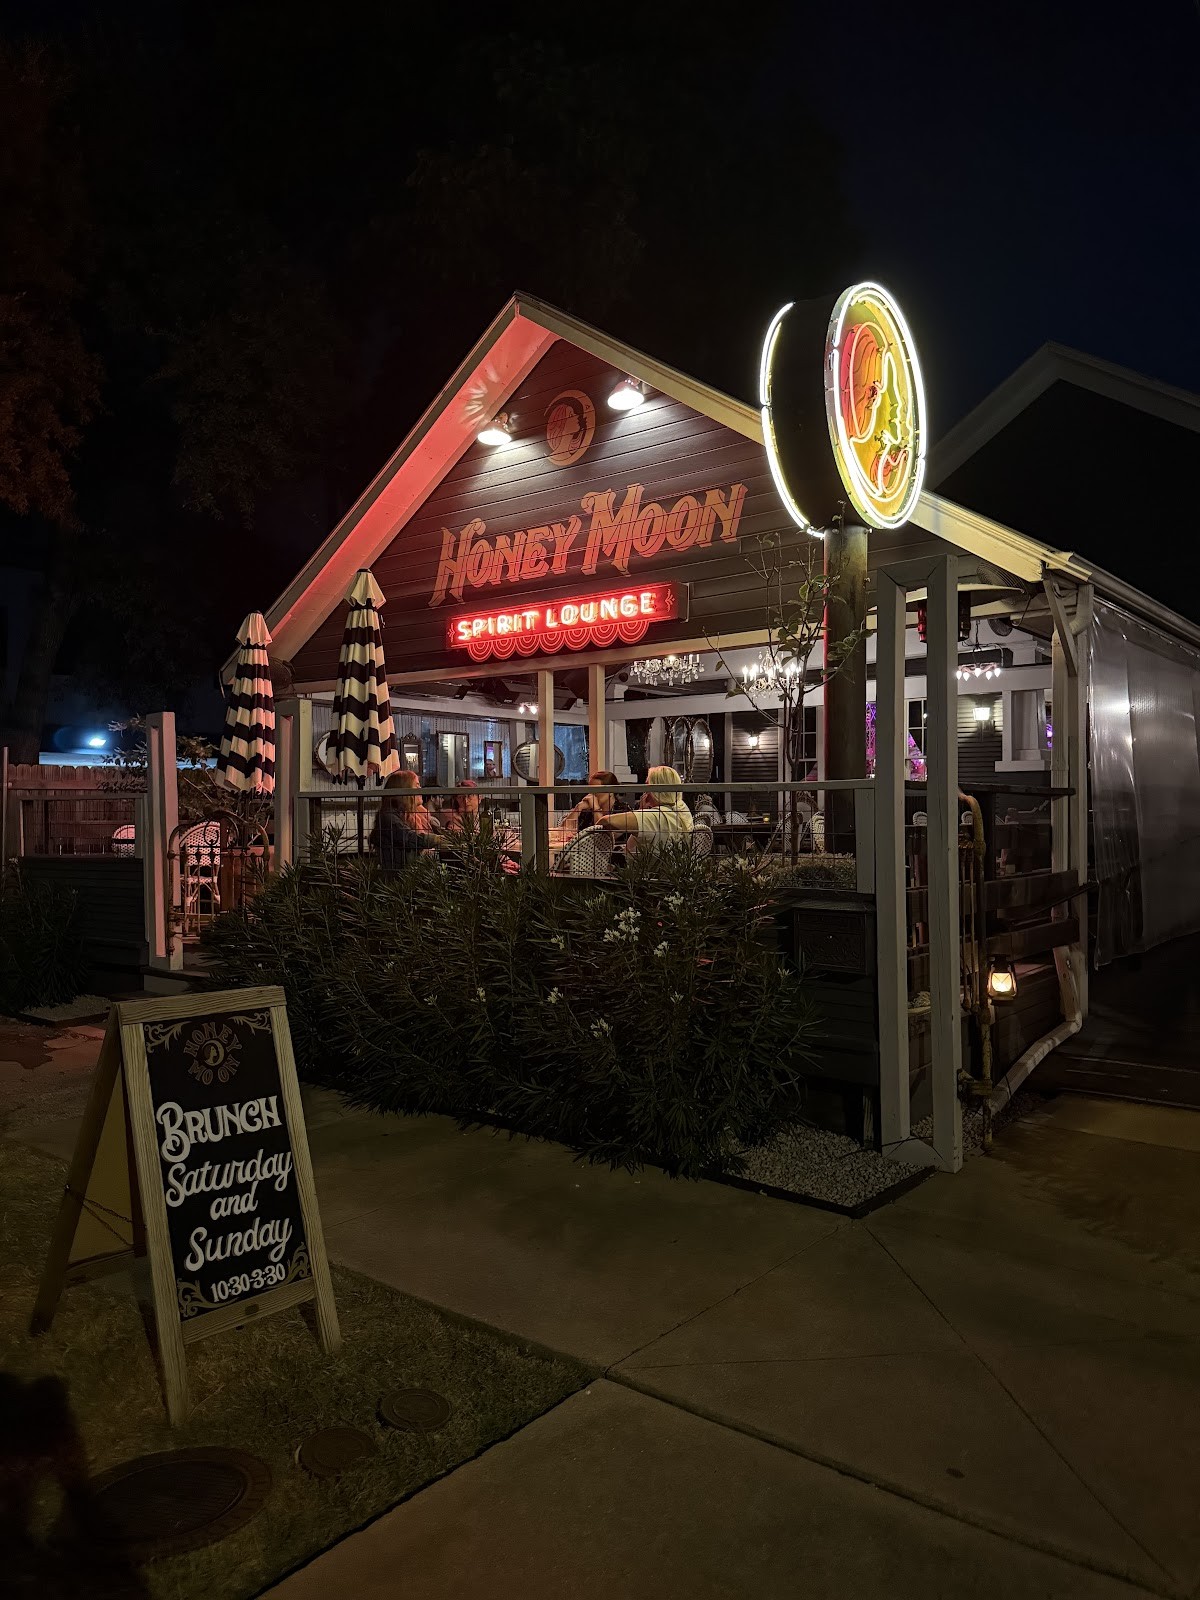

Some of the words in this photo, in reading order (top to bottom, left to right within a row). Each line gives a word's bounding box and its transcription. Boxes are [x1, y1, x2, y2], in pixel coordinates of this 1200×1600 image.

[428, 514, 582, 607] HONEY
[580, 483, 748, 577] MOON
[457, 609, 541, 642] SPIRIT
[545, 591, 658, 628] LOUNGE
[183, 1022, 243, 1057] HONEY
[187, 1053, 241, 1085] MOON
[156, 1095, 283, 1163] BRUNCH
[166, 1148, 293, 1208] Saturday
[209, 1180, 259, 1221] and
[184, 1216, 293, 1272] Sunday
